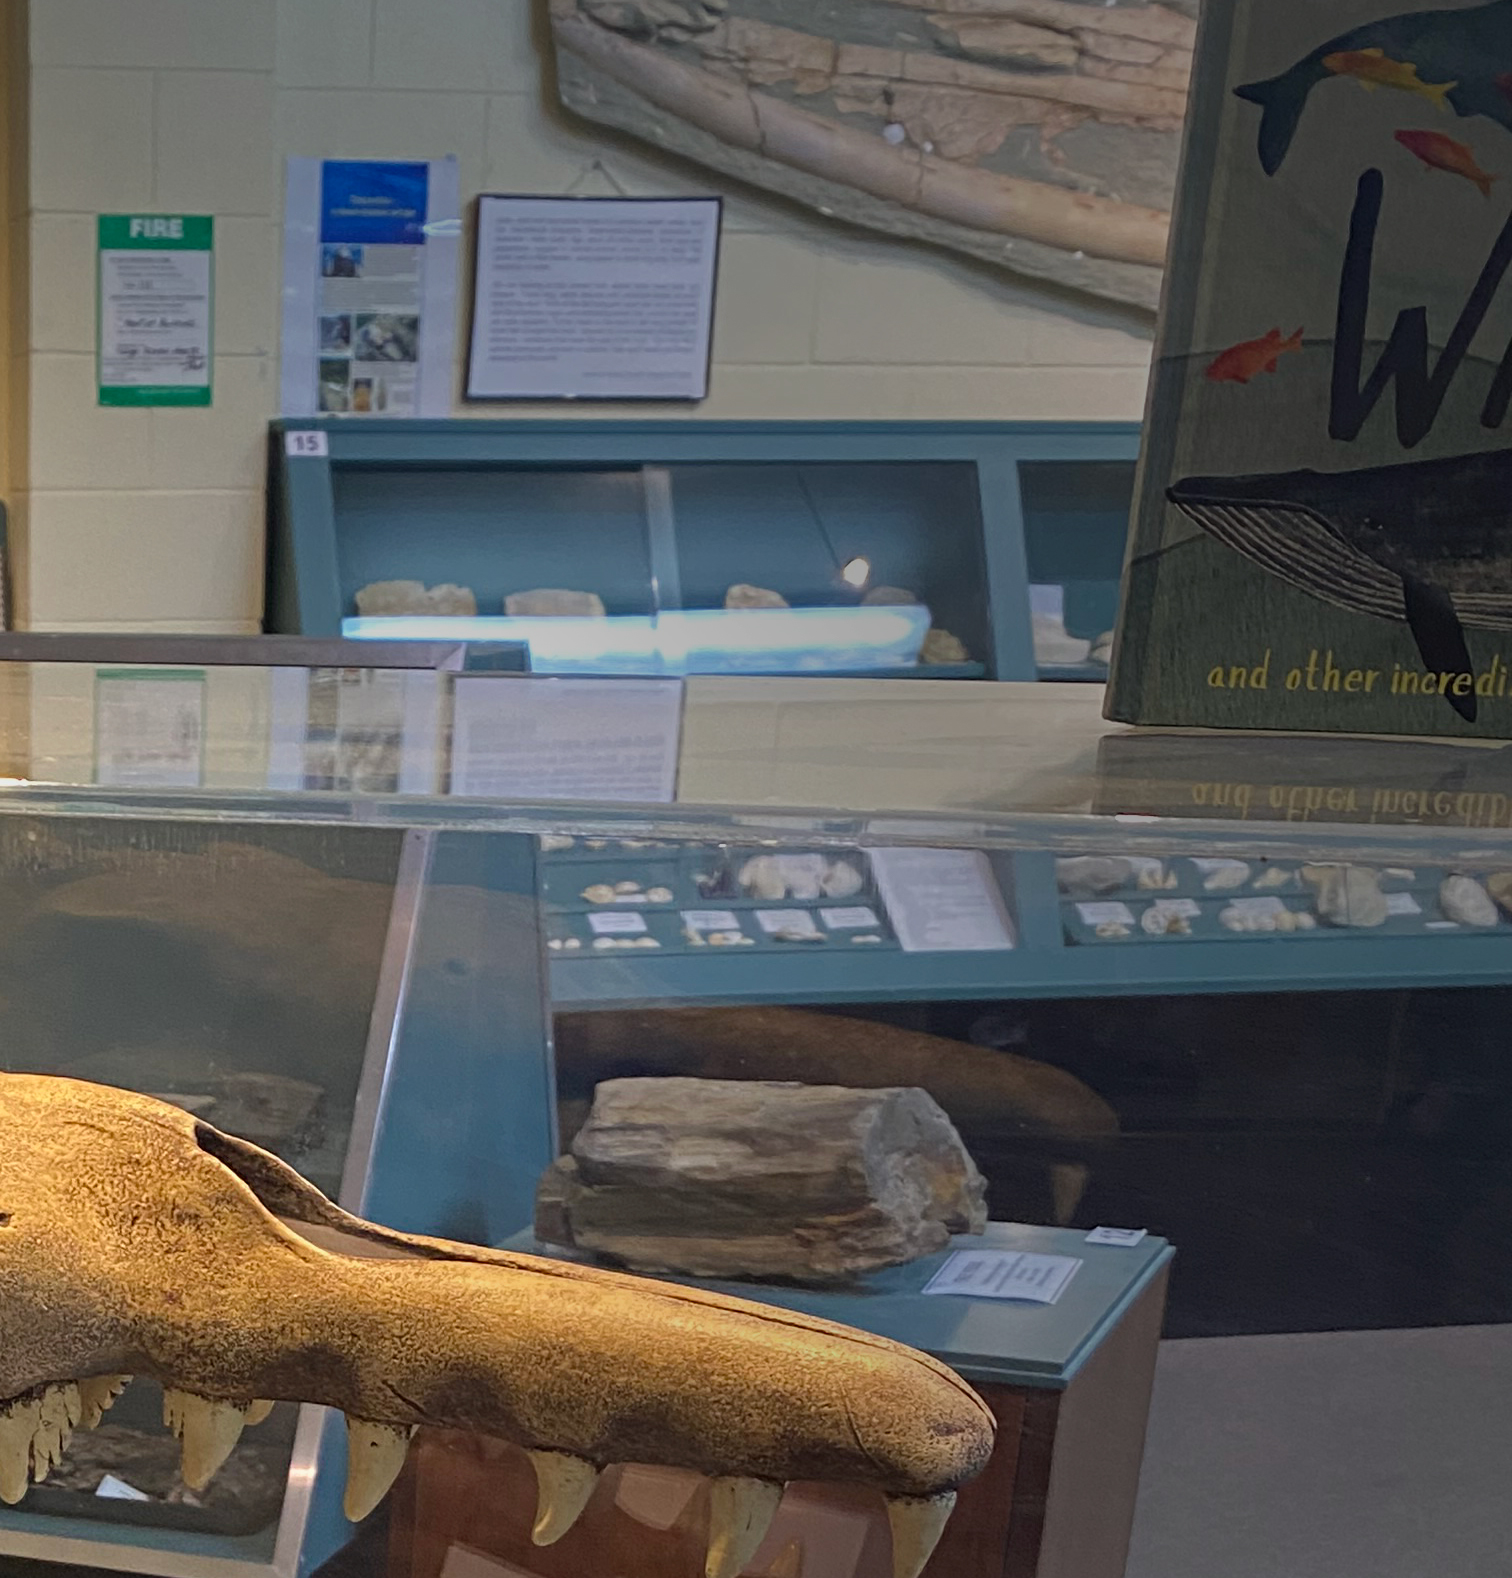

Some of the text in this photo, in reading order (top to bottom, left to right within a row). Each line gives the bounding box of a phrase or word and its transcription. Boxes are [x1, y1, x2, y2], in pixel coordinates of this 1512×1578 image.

[129, 217, 184, 239] FIRE
[1327, 166, 1512, 450] W
[294, 435, 320, 452] 15
[1206, 647, 1512, 697] and other incredi
